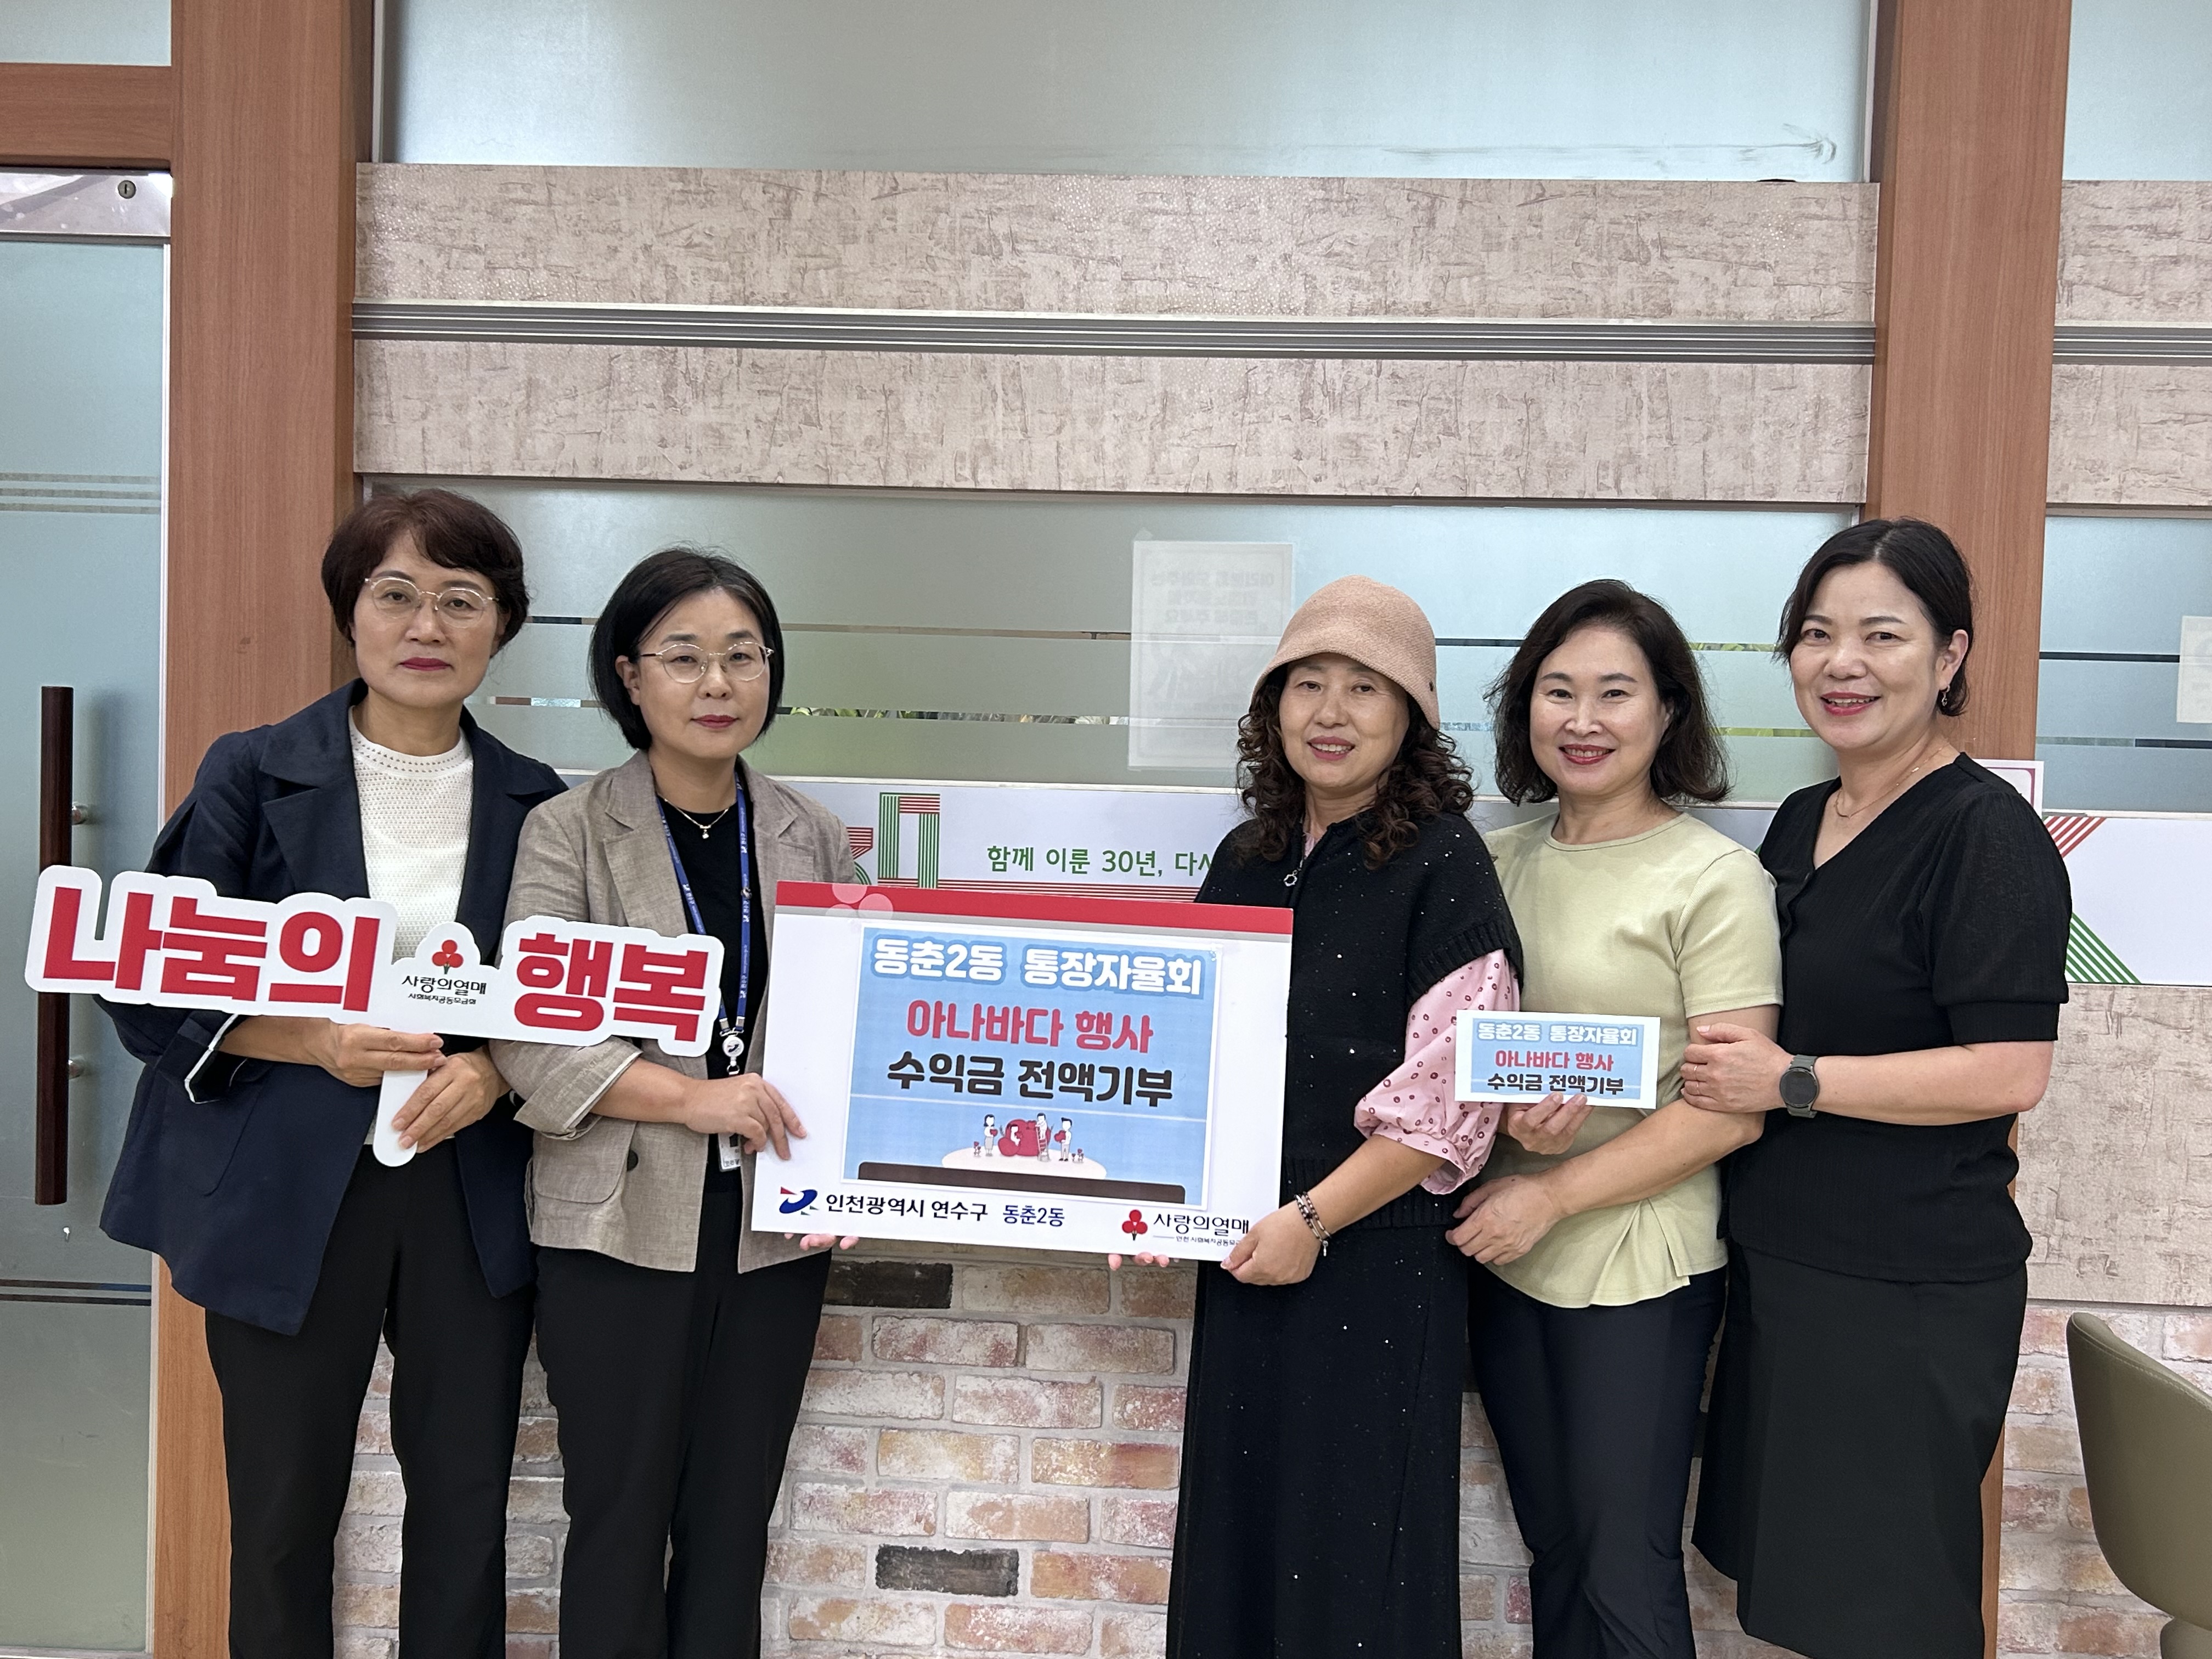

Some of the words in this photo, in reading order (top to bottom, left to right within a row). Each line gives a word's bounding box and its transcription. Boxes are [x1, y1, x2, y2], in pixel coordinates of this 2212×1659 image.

[988, 845, 1034, 872] 함께
[1046, 847, 1091, 874] 이룬
[1102, 849, 1163, 877] 30년,
[43, 886, 380, 1013] 나눔의
[514, 932, 709, 1042] 행복
[874, 938, 1005, 981] 동춘2동
[1024, 948, 1202, 996] 통장자율회
[402, 975, 487, 996] 사랑의열매
[907, 999, 1064, 1047] 아나바다
[1075, 1010, 1154, 1053] 행사
[1478, 1023, 1541, 1041] 동춘2동
[1549, 1024, 1637, 1045] 통장자율회
[1495, 1050, 1570, 1069] 아나바다
[1575, 1052, 1614, 1071] 행사
[887, 1051, 1005, 1096] 수익금
[1018, 1059, 1173, 1108] 전액기부
[1487, 1073, 1543, 1092] 수익금
[1548, 1074, 1624, 1095] 전액기부
[826, 1194, 925, 1218] 인천광역시
[931, 1200, 989, 1222] 연수구
[1002, 1204, 1066, 1227] 동춘2동
[1153, 1214, 1250, 1237] 사랑의열매
